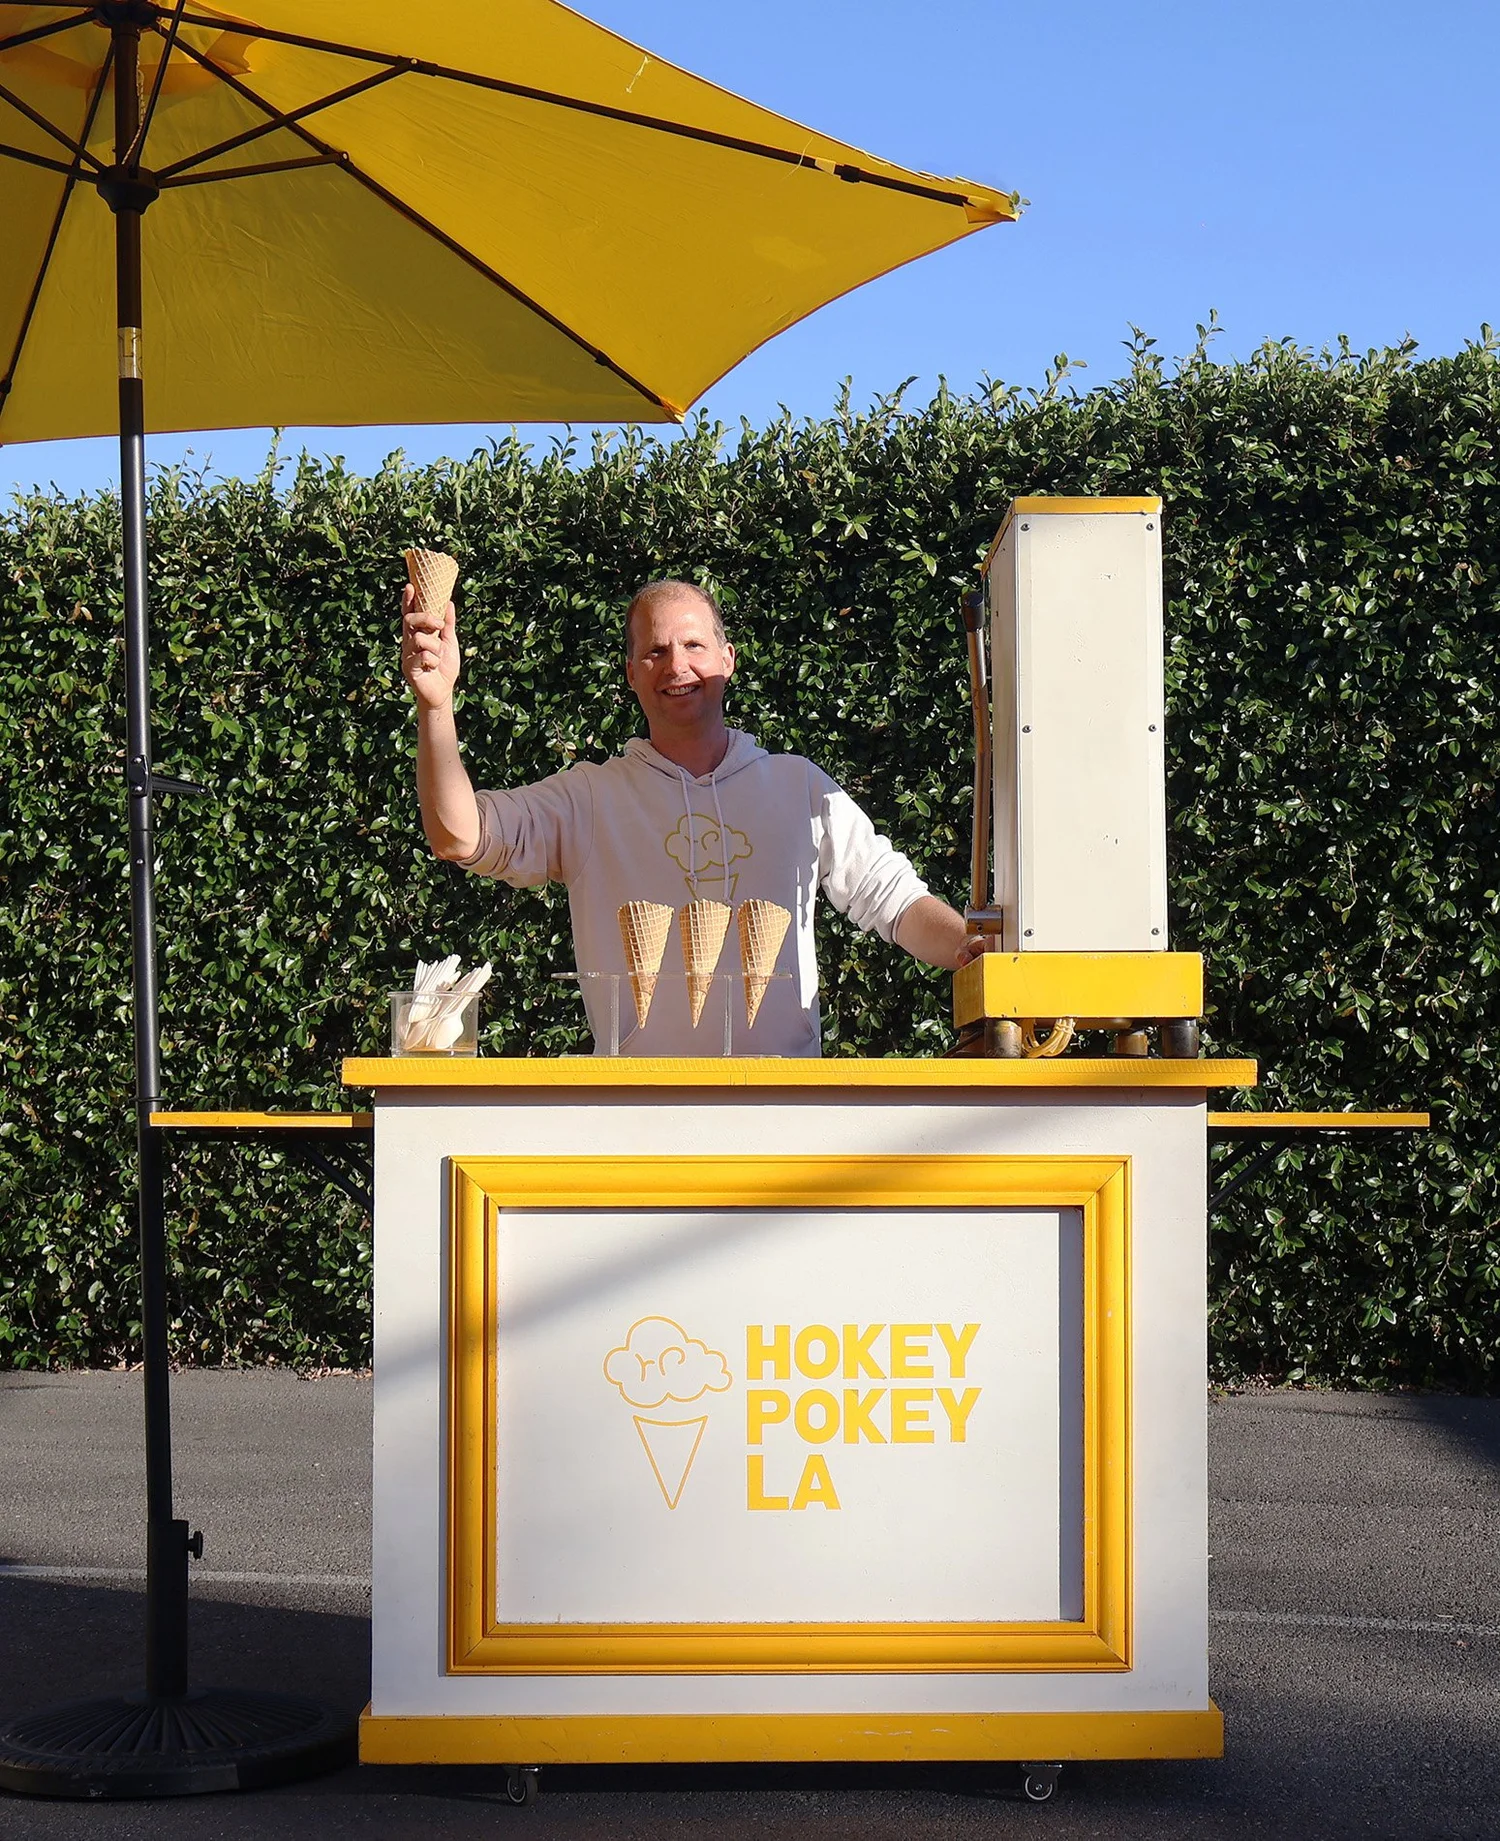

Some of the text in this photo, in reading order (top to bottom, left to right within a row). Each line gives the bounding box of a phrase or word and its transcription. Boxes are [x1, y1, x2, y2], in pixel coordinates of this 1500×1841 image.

[747, 1323, 981, 1380] HOKEY
[747, 1388, 982, 1445] POKEY
[747, 1454, 841, 1511] LA
